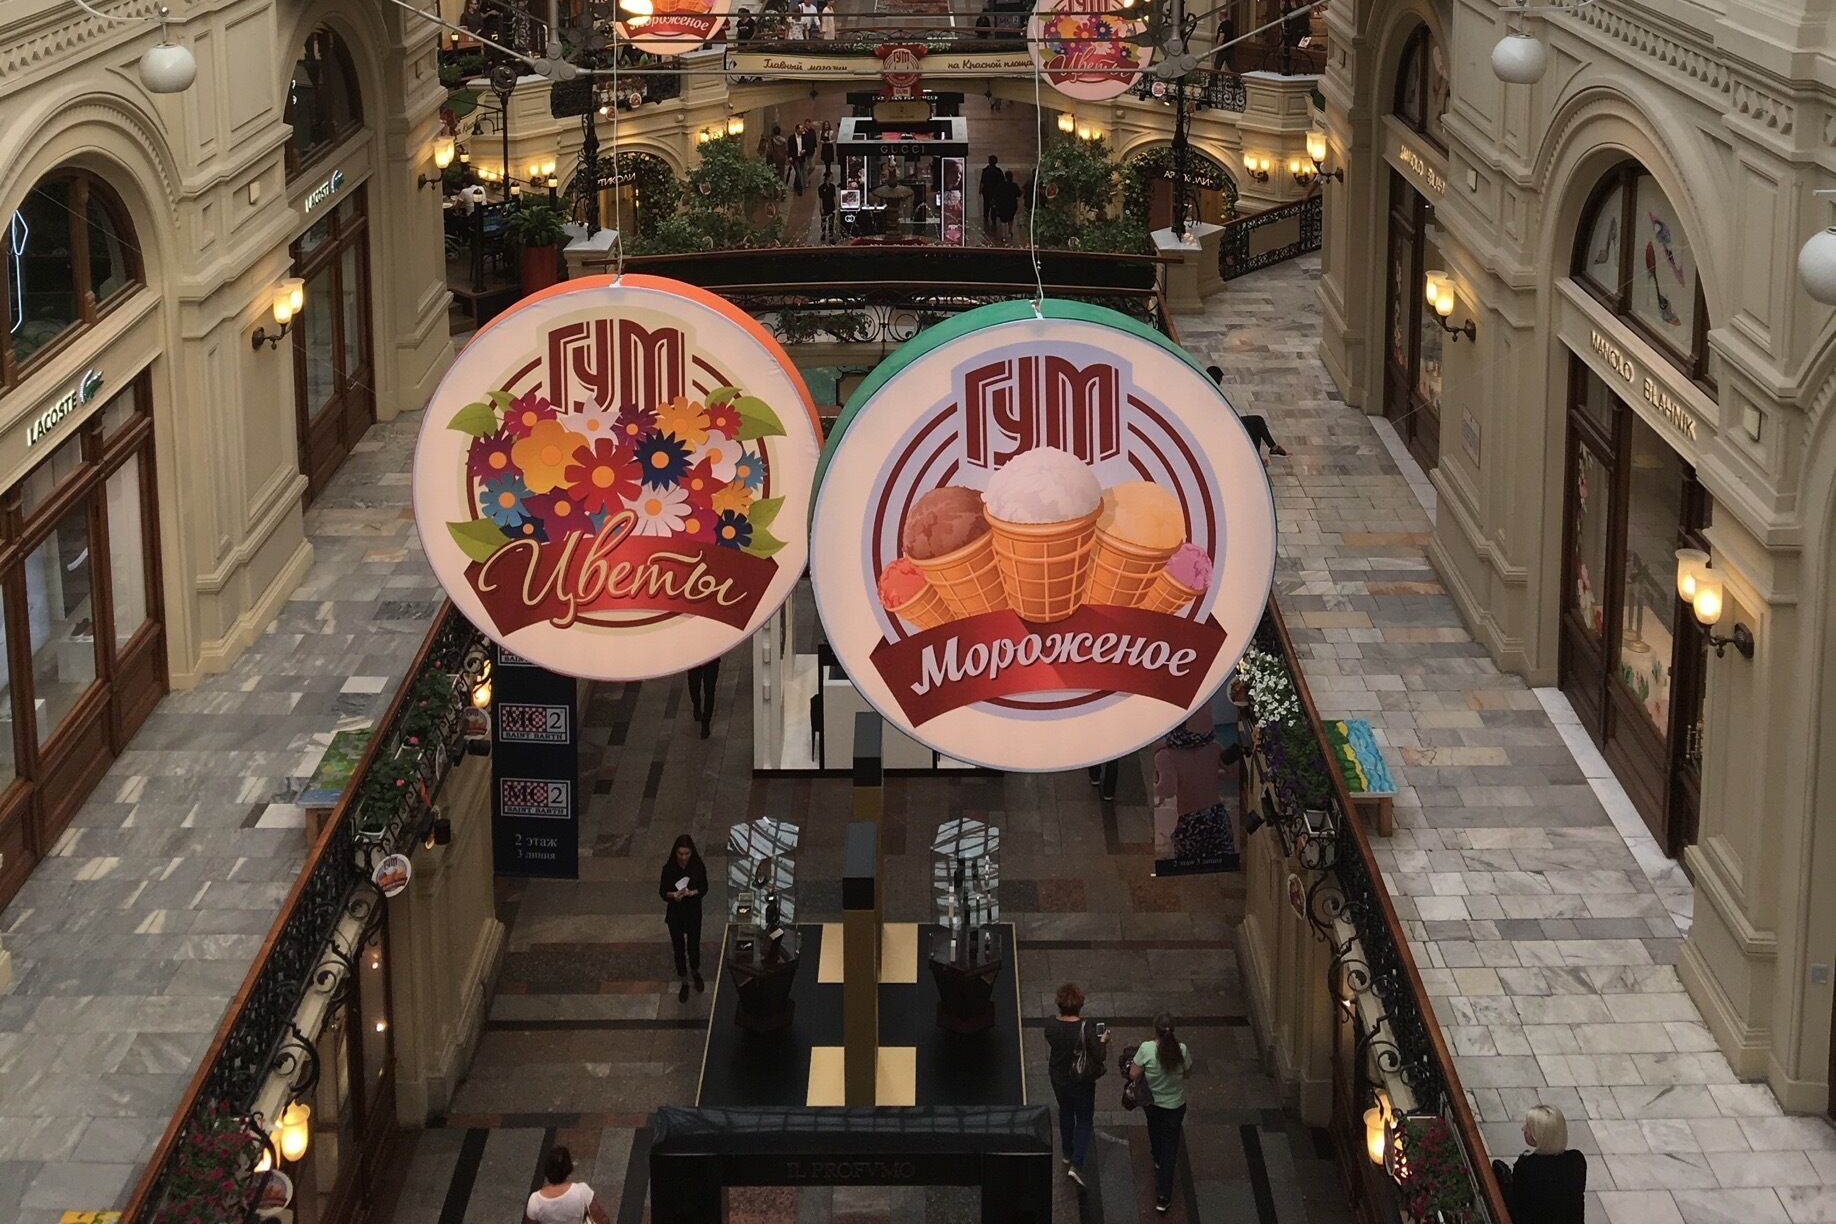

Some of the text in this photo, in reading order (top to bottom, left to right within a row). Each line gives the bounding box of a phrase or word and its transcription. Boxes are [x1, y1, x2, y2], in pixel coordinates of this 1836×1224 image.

[763, 58, 803, 71] Главный
[962, 59, 1002, 69] Красной
[1004, 59, 1035, 68] площа
[880, 145, 925, 154] GUCCI
[548, 319, 685, 414] ГУМ
[1590, 329, 1697, 441] MANOLO BLAHNIK
[27, 389, 78, 447] LACOSTE
[965, 356, 1120, 470] ГУМ
[478, 510, 748, 626] Цветы
[911, 633, 1197, 696] Мороженое
[515, 833, 558, 848] 2 этаж
